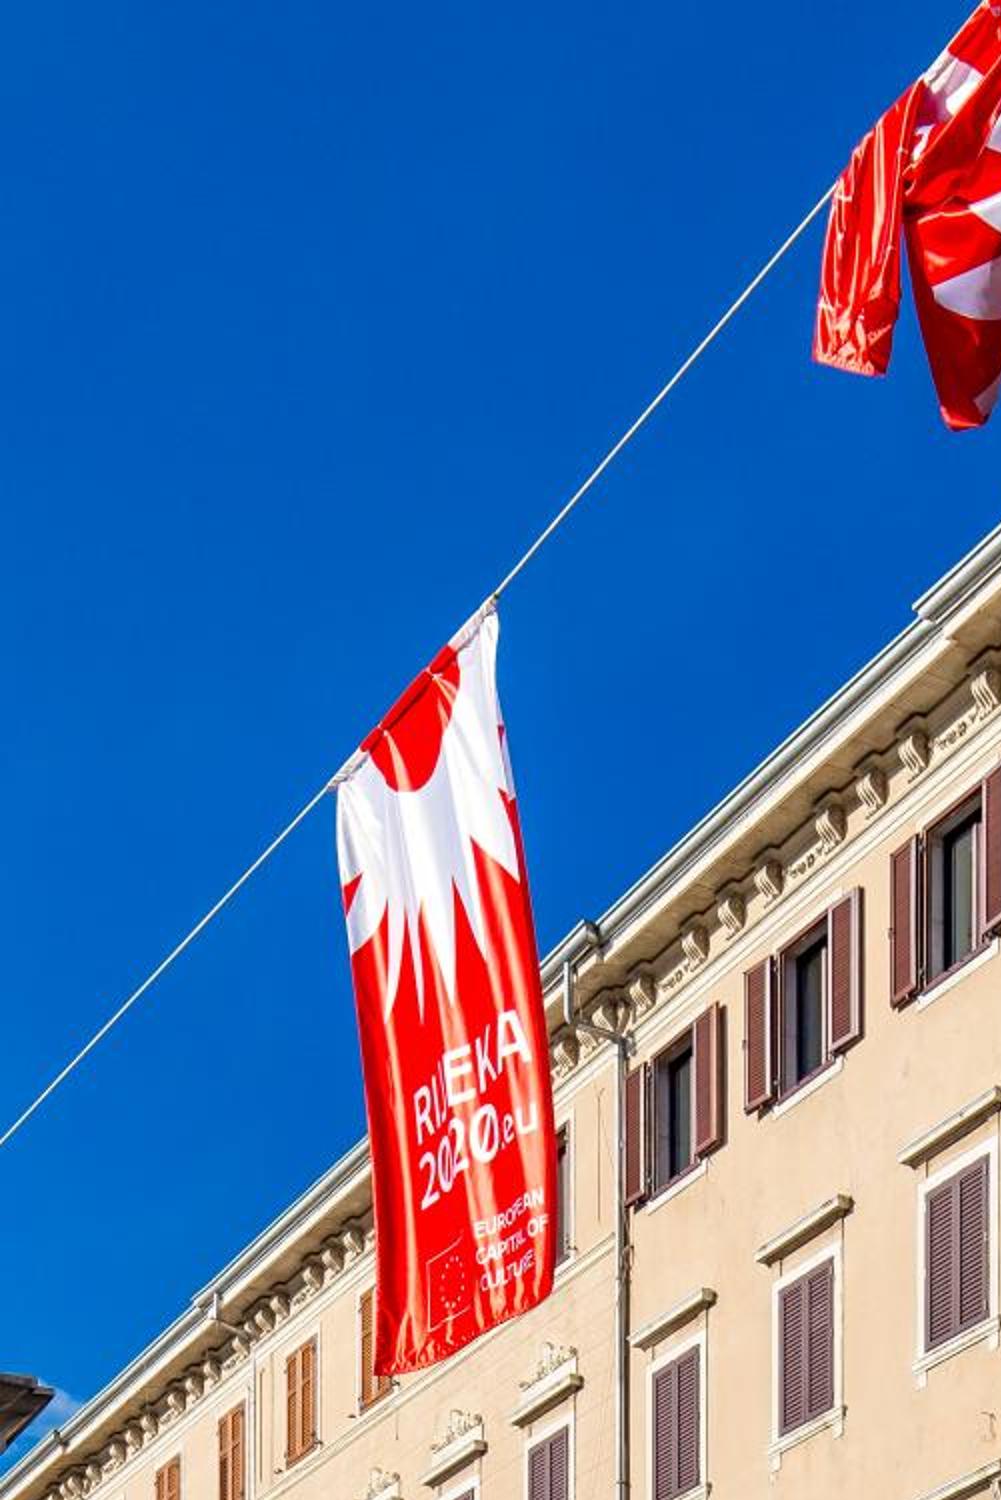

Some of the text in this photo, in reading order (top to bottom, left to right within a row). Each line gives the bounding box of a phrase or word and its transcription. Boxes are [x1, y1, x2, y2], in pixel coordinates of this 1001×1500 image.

[413, 1009, 532, 1145] RIJEKA
[419, 1103, 538, 1210] 2020.eu
[474, 1187, 545, 1238] EUROPEAN
[527, 1214, 548, 1237] OF
